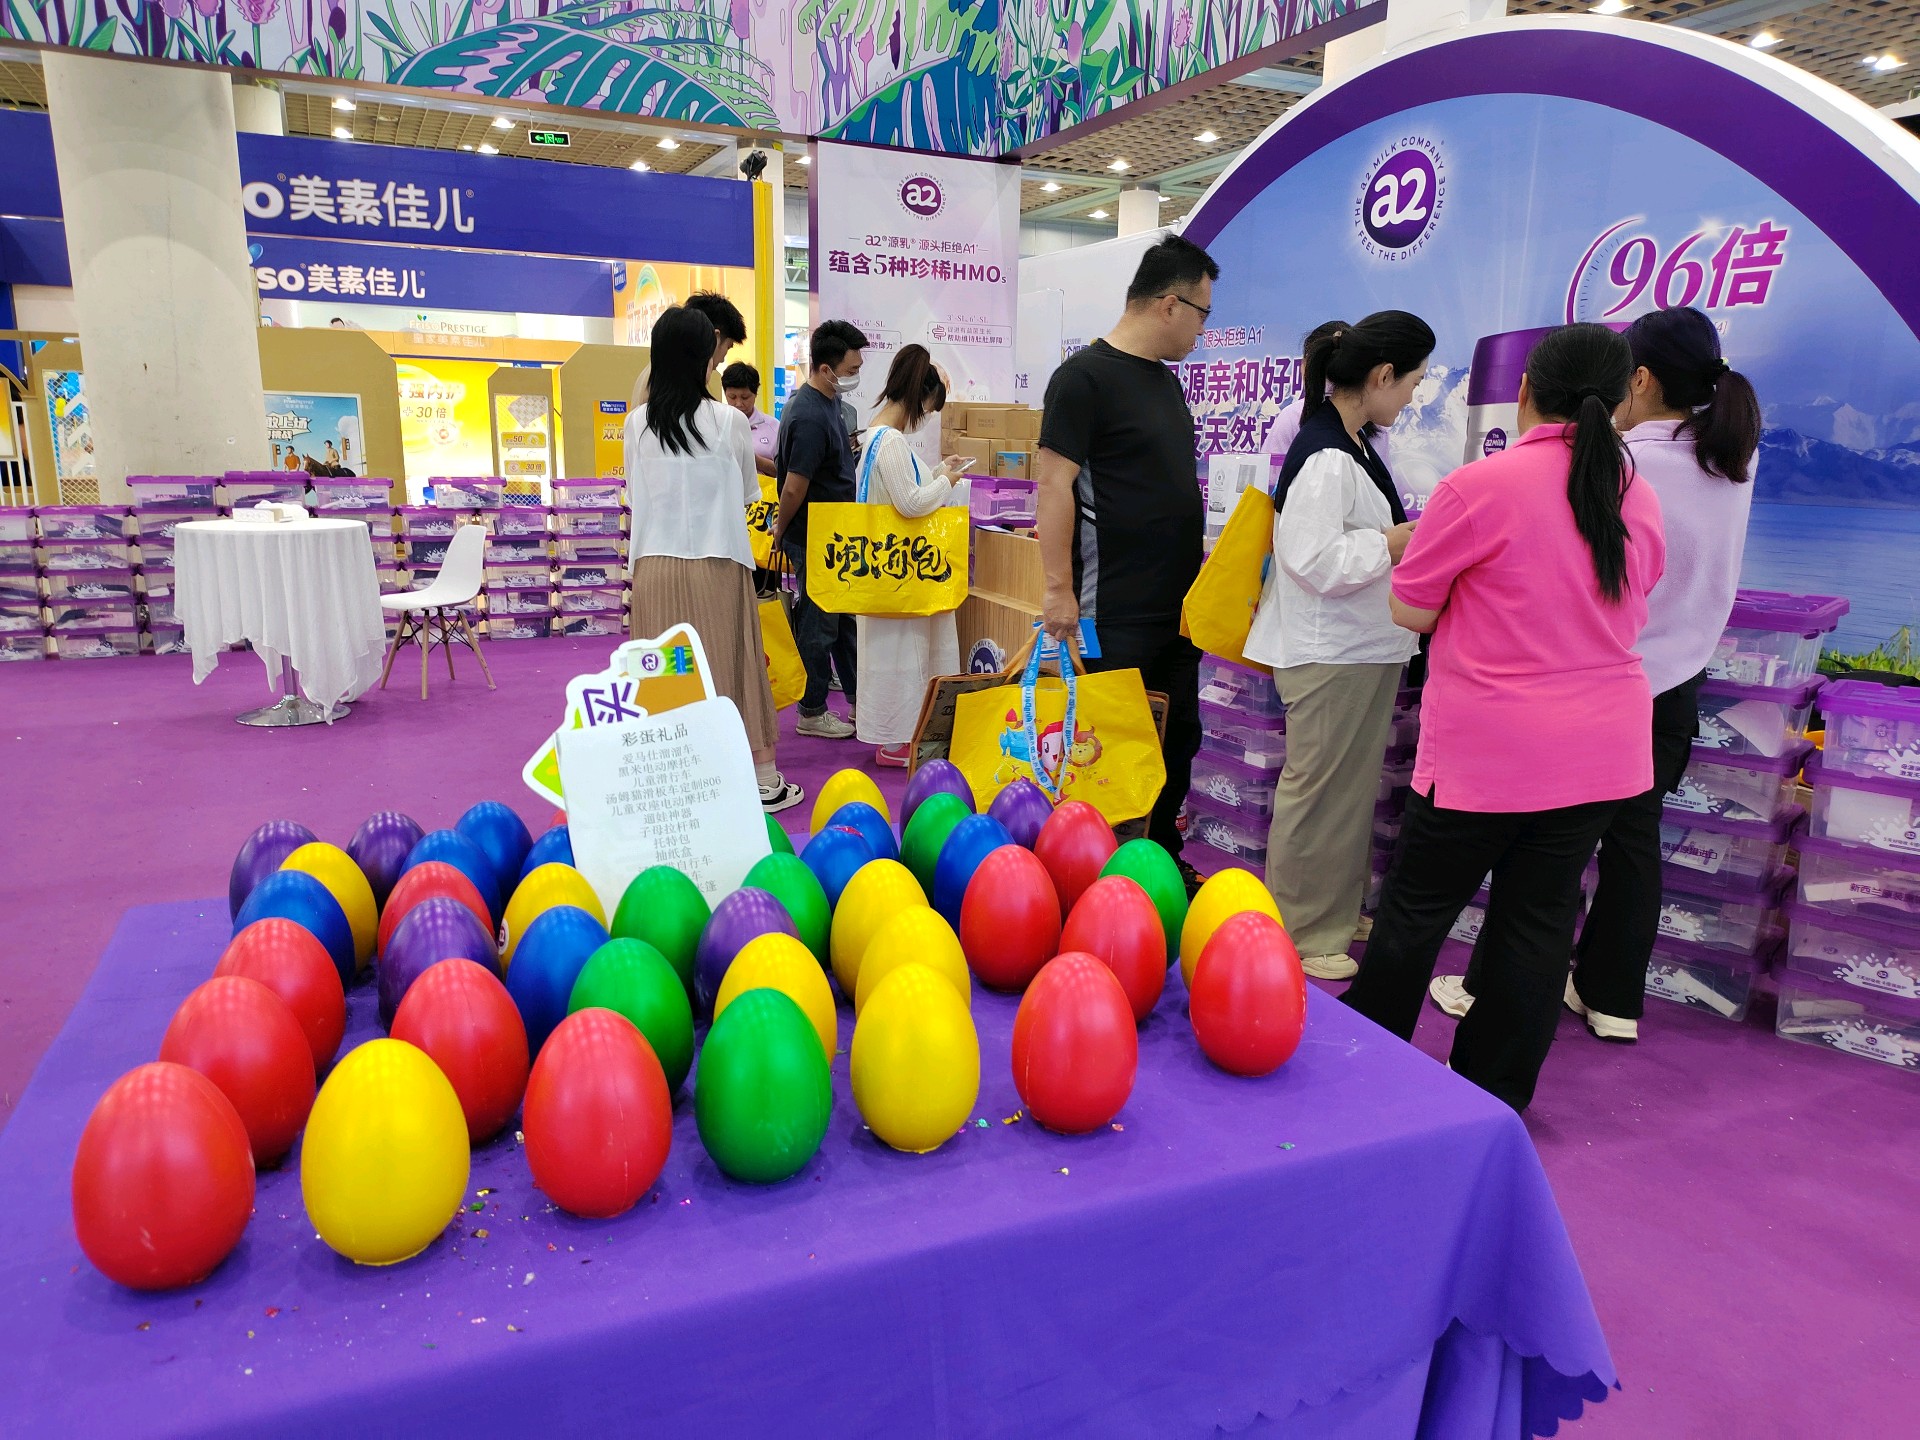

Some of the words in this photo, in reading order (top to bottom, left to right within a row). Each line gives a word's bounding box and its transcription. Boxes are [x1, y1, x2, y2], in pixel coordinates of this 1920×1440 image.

[1354, 197, 1363, 227] THE
[1372, 143, 1398, 169] MILK
[1401, 136, 1445, 170] COMPANY
[906, 183, 938, 208] a2
[1370, 167, 1427, 229] a2
[1357, 230, 1375, 255] FEEL
[1378, 249, 1396, 261] THE
[1401, 176, 1446, 260] DIFFERENCE
[829, 249, 1007, 283] 蕴含5种珍稀HMOs
[1603, 221, 1787, 317] 96倍
[622, 723, 688, 747] 彩蛋礼品
[618, 754, 702, 778] 黑米电动摩托车
[633, 769, 692, 788] 儿童滑行车
[612, 788, 720, 817] 儿童双座电动摩托车
[640, 818, 700, 838] 子母拉杆箱
[654, 833, 691, 849] 托特包
[656, 846, 693, 862] 抽纸盒
